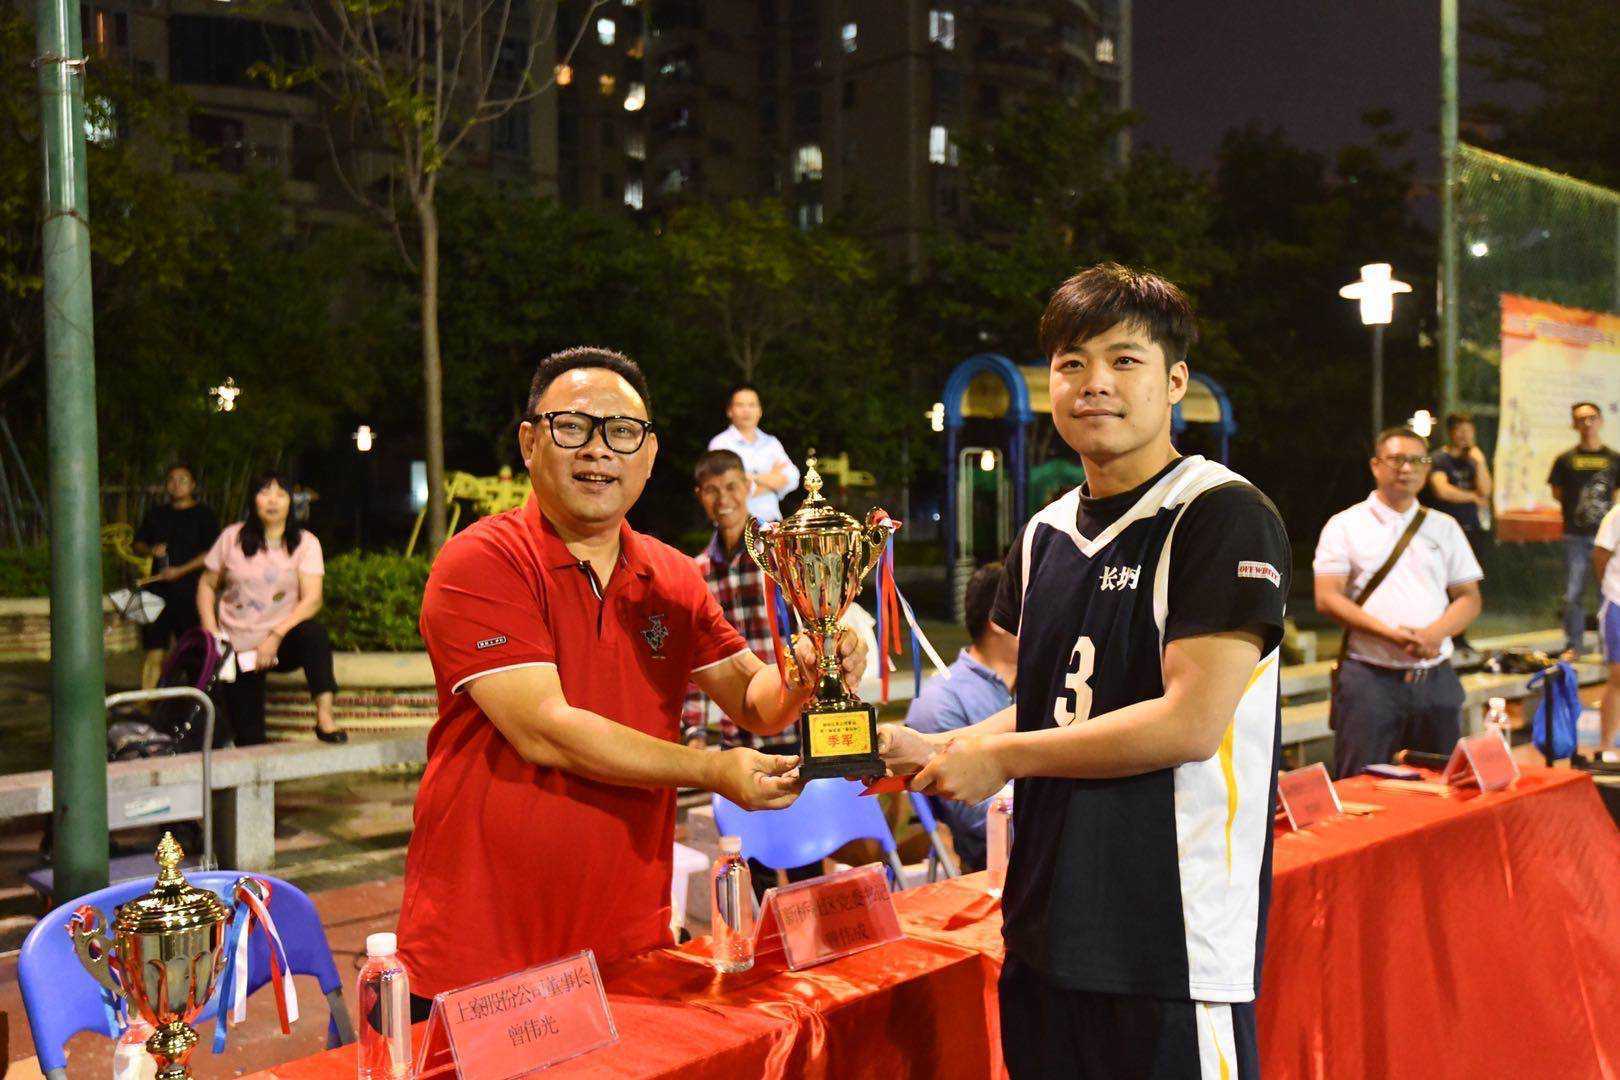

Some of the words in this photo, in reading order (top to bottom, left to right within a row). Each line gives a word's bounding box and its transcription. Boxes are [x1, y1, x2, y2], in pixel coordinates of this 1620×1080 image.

[1053, 635, 1096, 728] 3
[508, 1015, 559, 1047] 曾伟光
